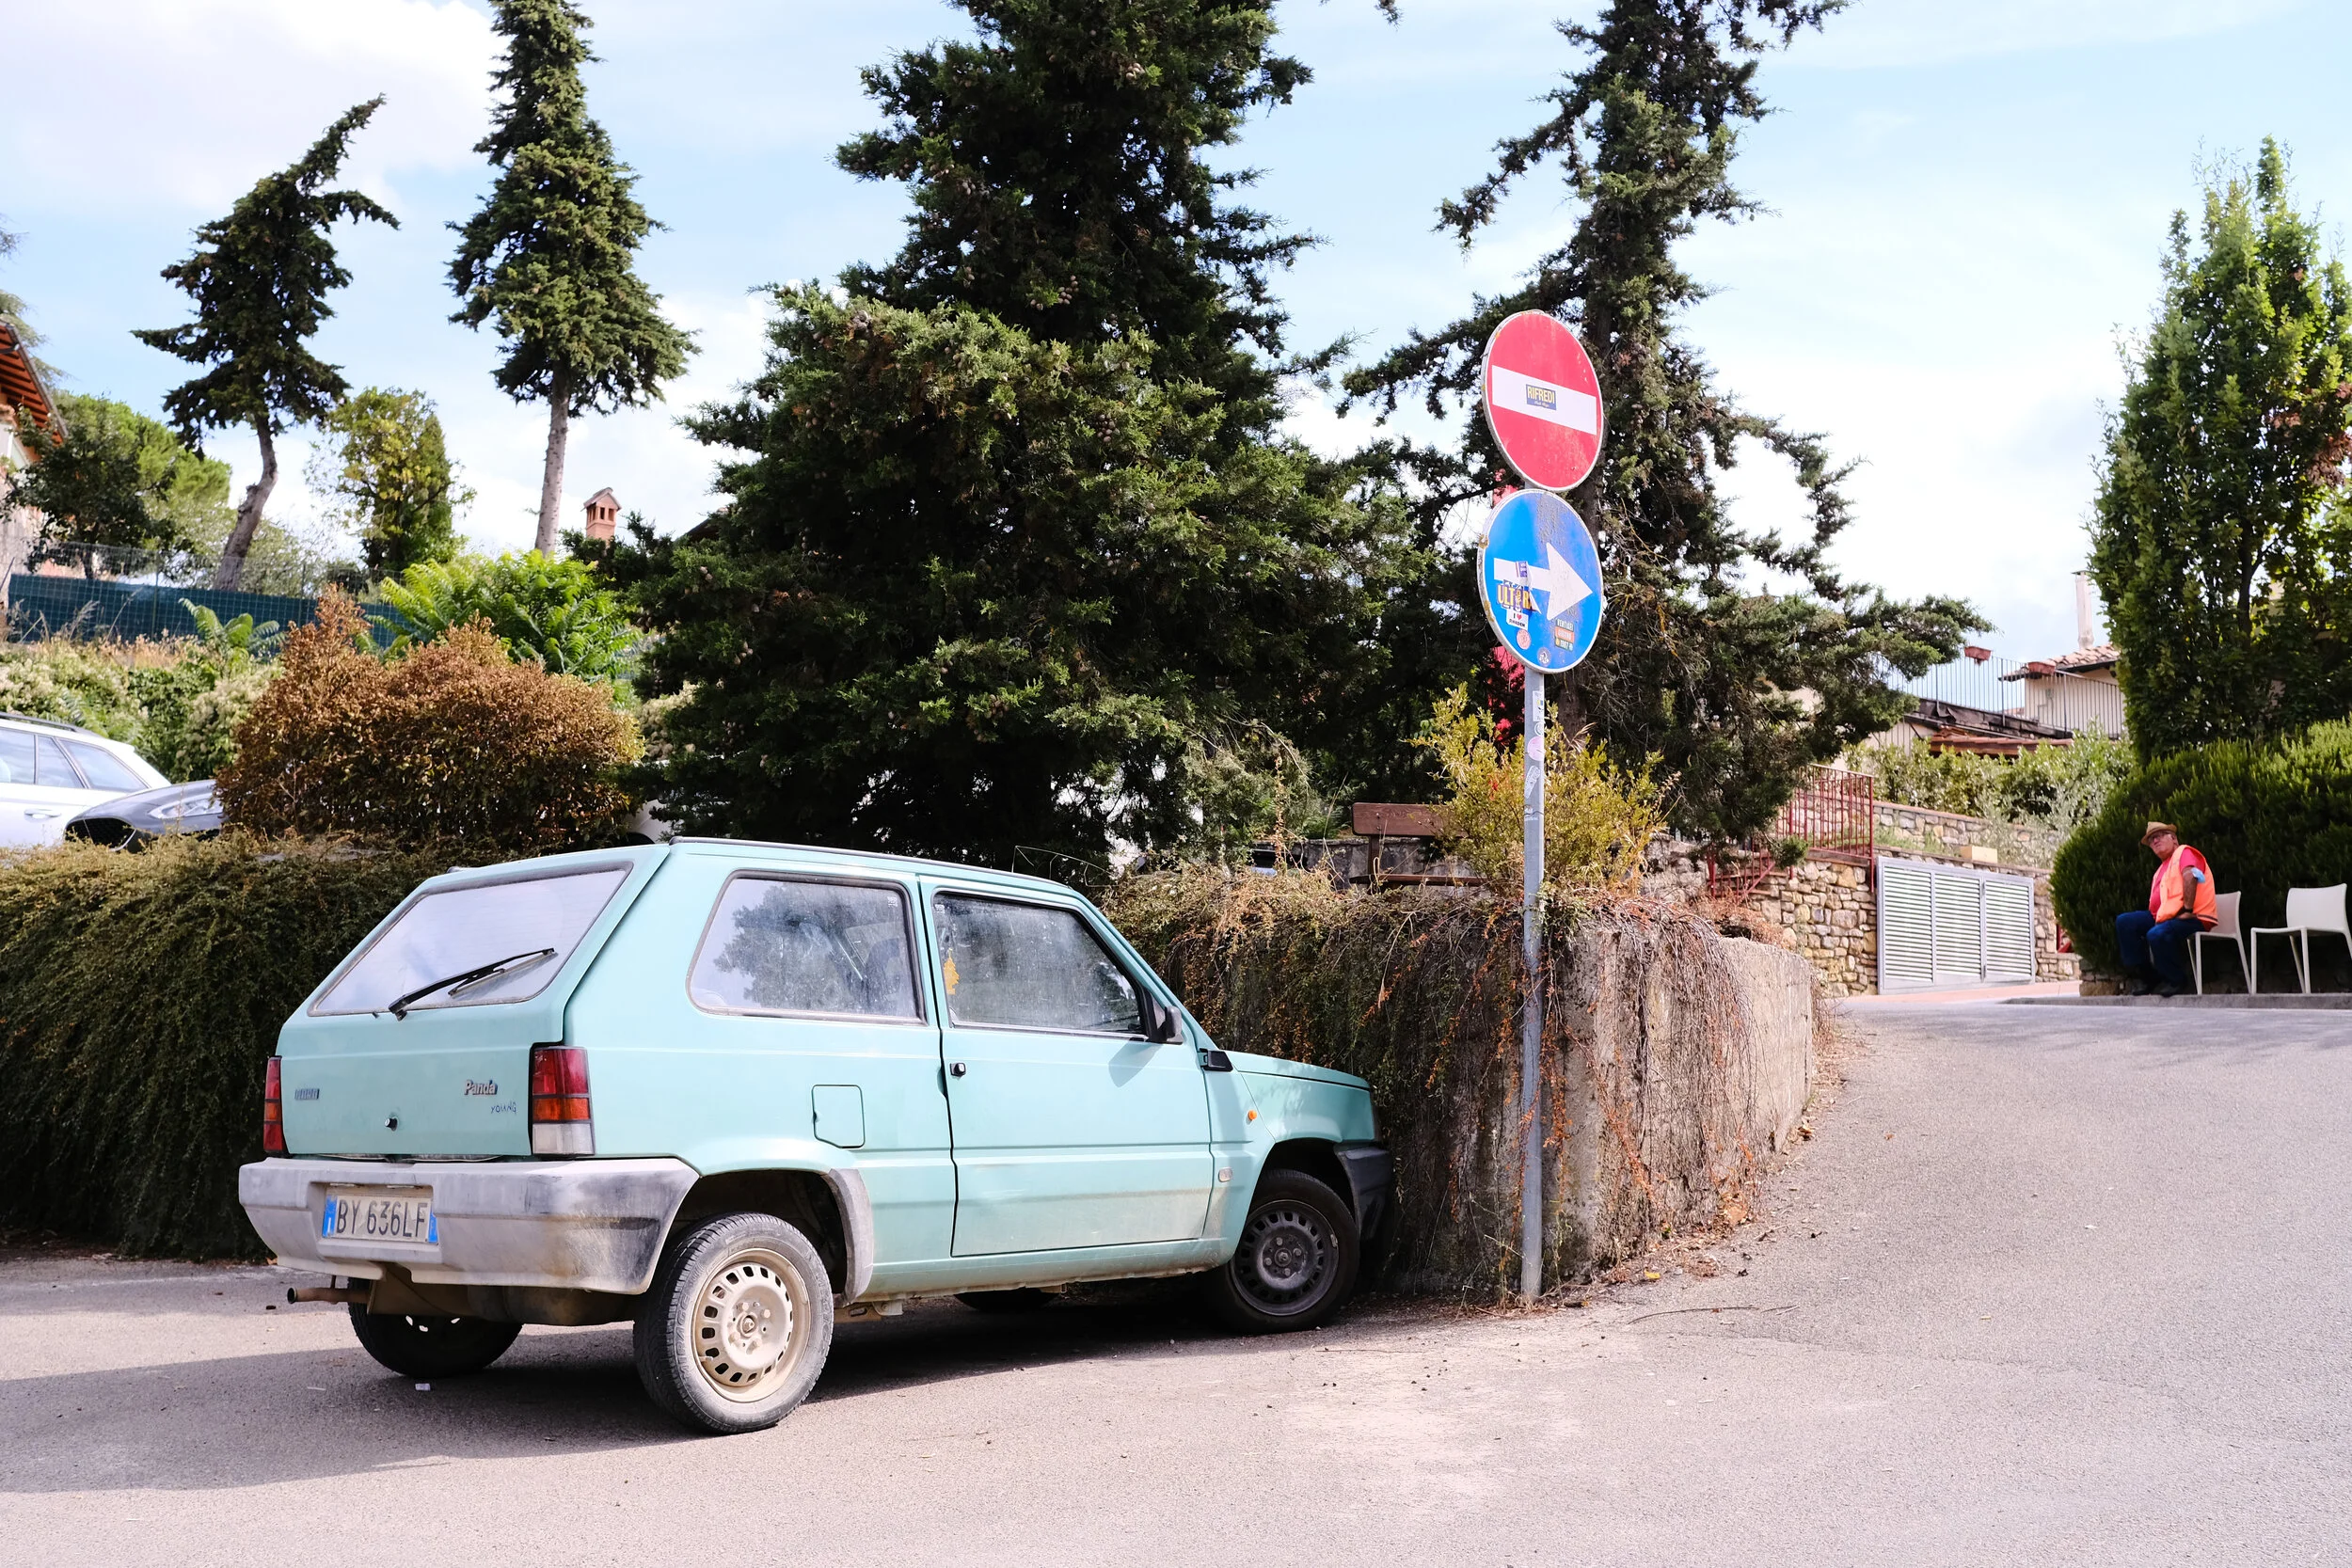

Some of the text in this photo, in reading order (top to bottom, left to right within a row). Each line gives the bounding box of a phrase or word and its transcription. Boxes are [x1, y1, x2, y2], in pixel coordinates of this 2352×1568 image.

[1527, 386, 1555, 404] RIFREDI
[463, 1079, 498, 1095] Panda
[336, 1199, 361, 1235] BY
[367, 1200, 428, 1238] 636LF
